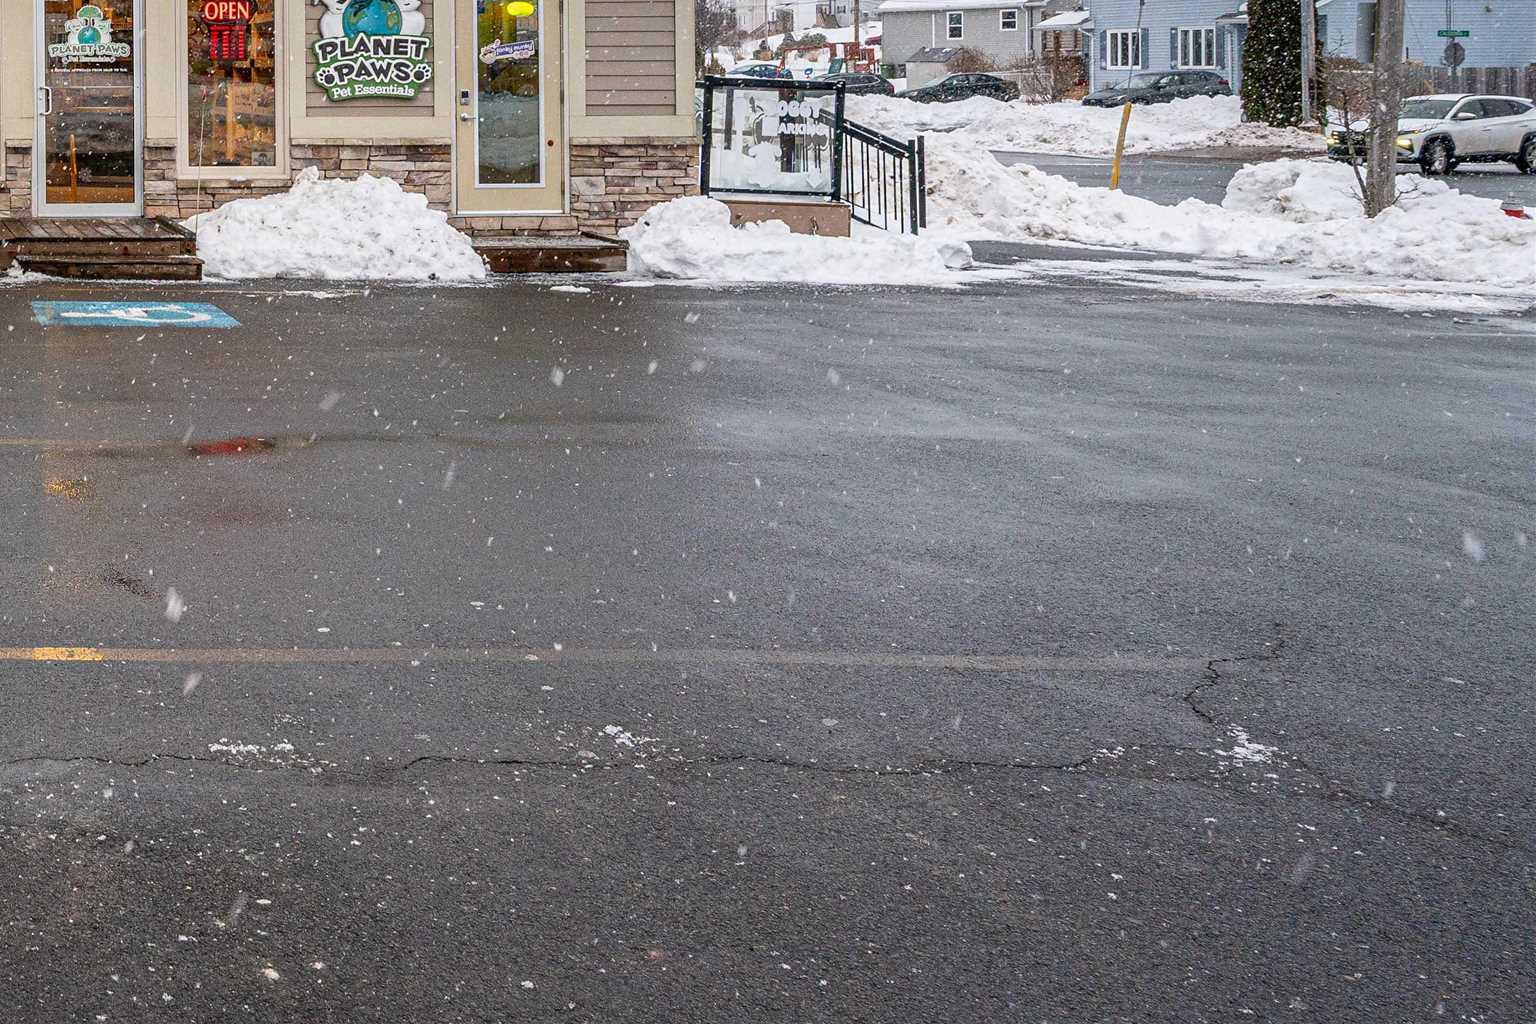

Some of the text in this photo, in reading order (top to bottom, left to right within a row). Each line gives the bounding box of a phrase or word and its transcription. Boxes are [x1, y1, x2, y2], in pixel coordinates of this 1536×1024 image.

[204, 1, 250, 20] OPEN
[51, 44, 128, 55] PLANET PAWS
[317, 35, 428, 63] PLANET
[332, 59, 413, 83] PAWS
[332, 83, 415, 98] Pet Essentials
[773, 100, 822, 118] OGGY
